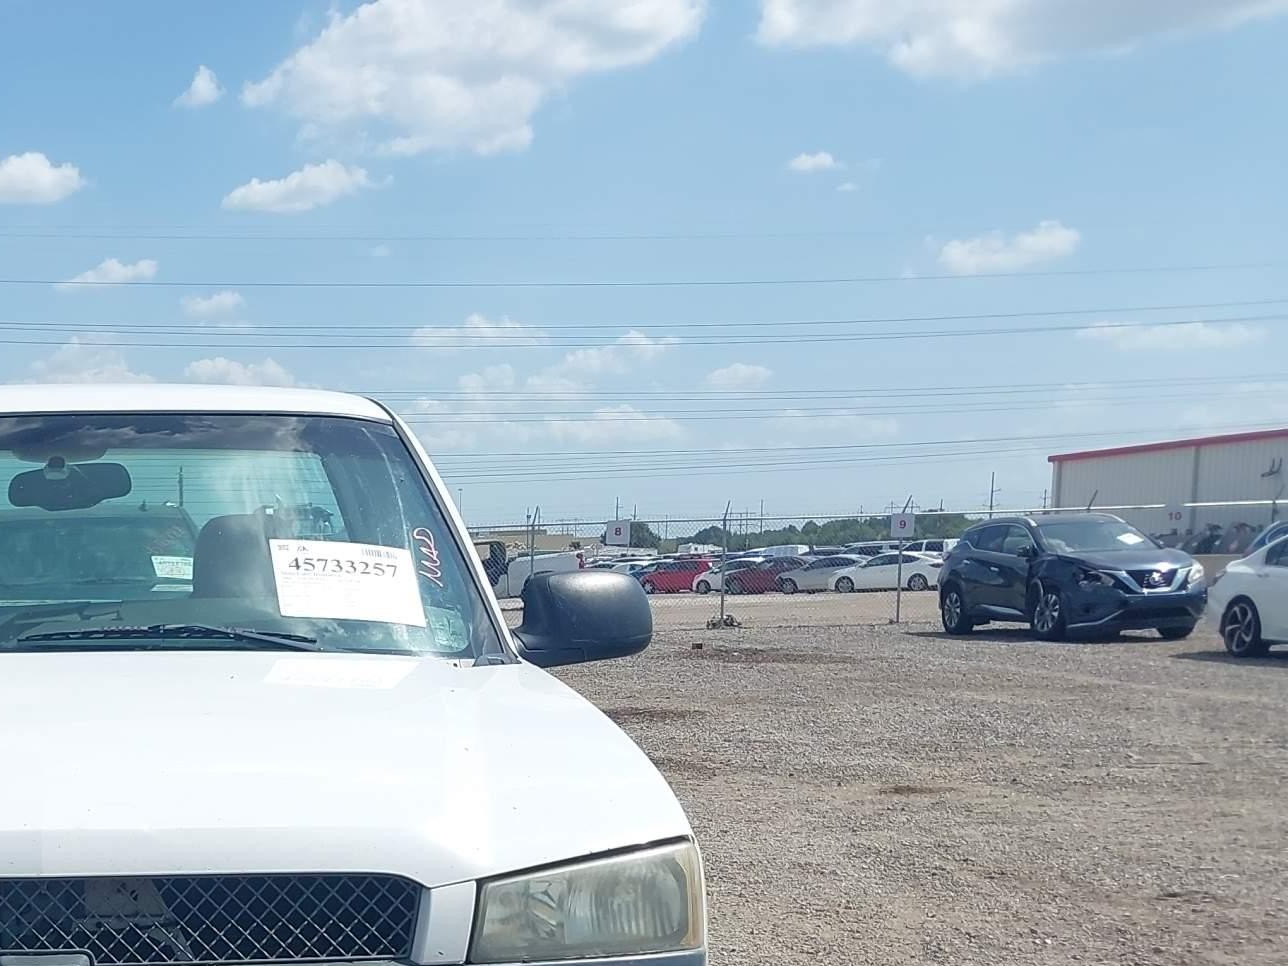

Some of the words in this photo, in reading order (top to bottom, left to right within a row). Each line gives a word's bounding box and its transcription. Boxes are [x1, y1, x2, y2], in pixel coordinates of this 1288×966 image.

[1168, 511, 1182, 521] 10
[899, 519, 907, 529] 9
[614, 527, 622, 536] 8
[288, 556, 398, 578] 45733257
